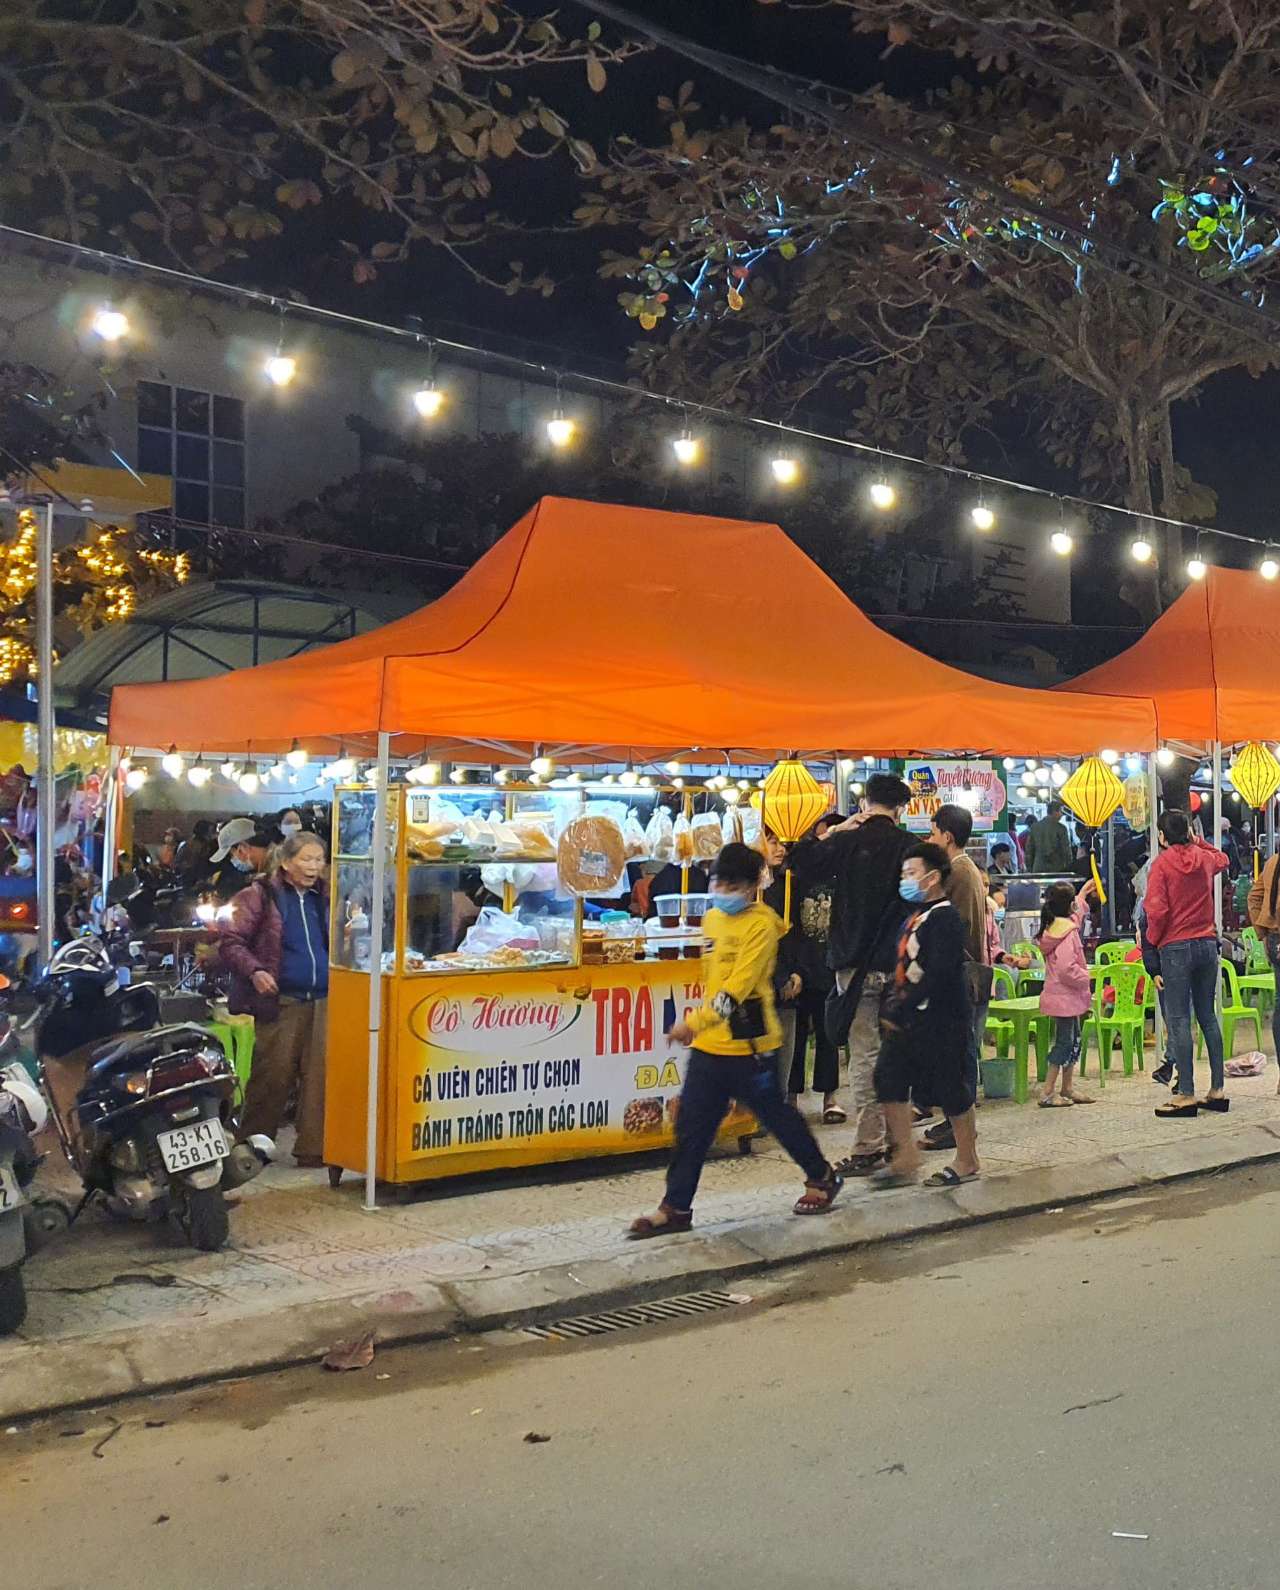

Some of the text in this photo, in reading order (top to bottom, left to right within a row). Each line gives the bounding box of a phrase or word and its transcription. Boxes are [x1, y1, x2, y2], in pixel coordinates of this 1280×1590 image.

[427, 993, 562, 1033] Cô Hương
[413, 1058, 581, 1104] CÁ VIÊN CHIÊN TỰ CHỌN
[169, 1124, 212, 1149] 43-K1
[411, 1099, 609, 1151] BÁNH TRÁNG TRỘN CÁC LOẠI
[168, 1139, 225, 1169] 258.16
